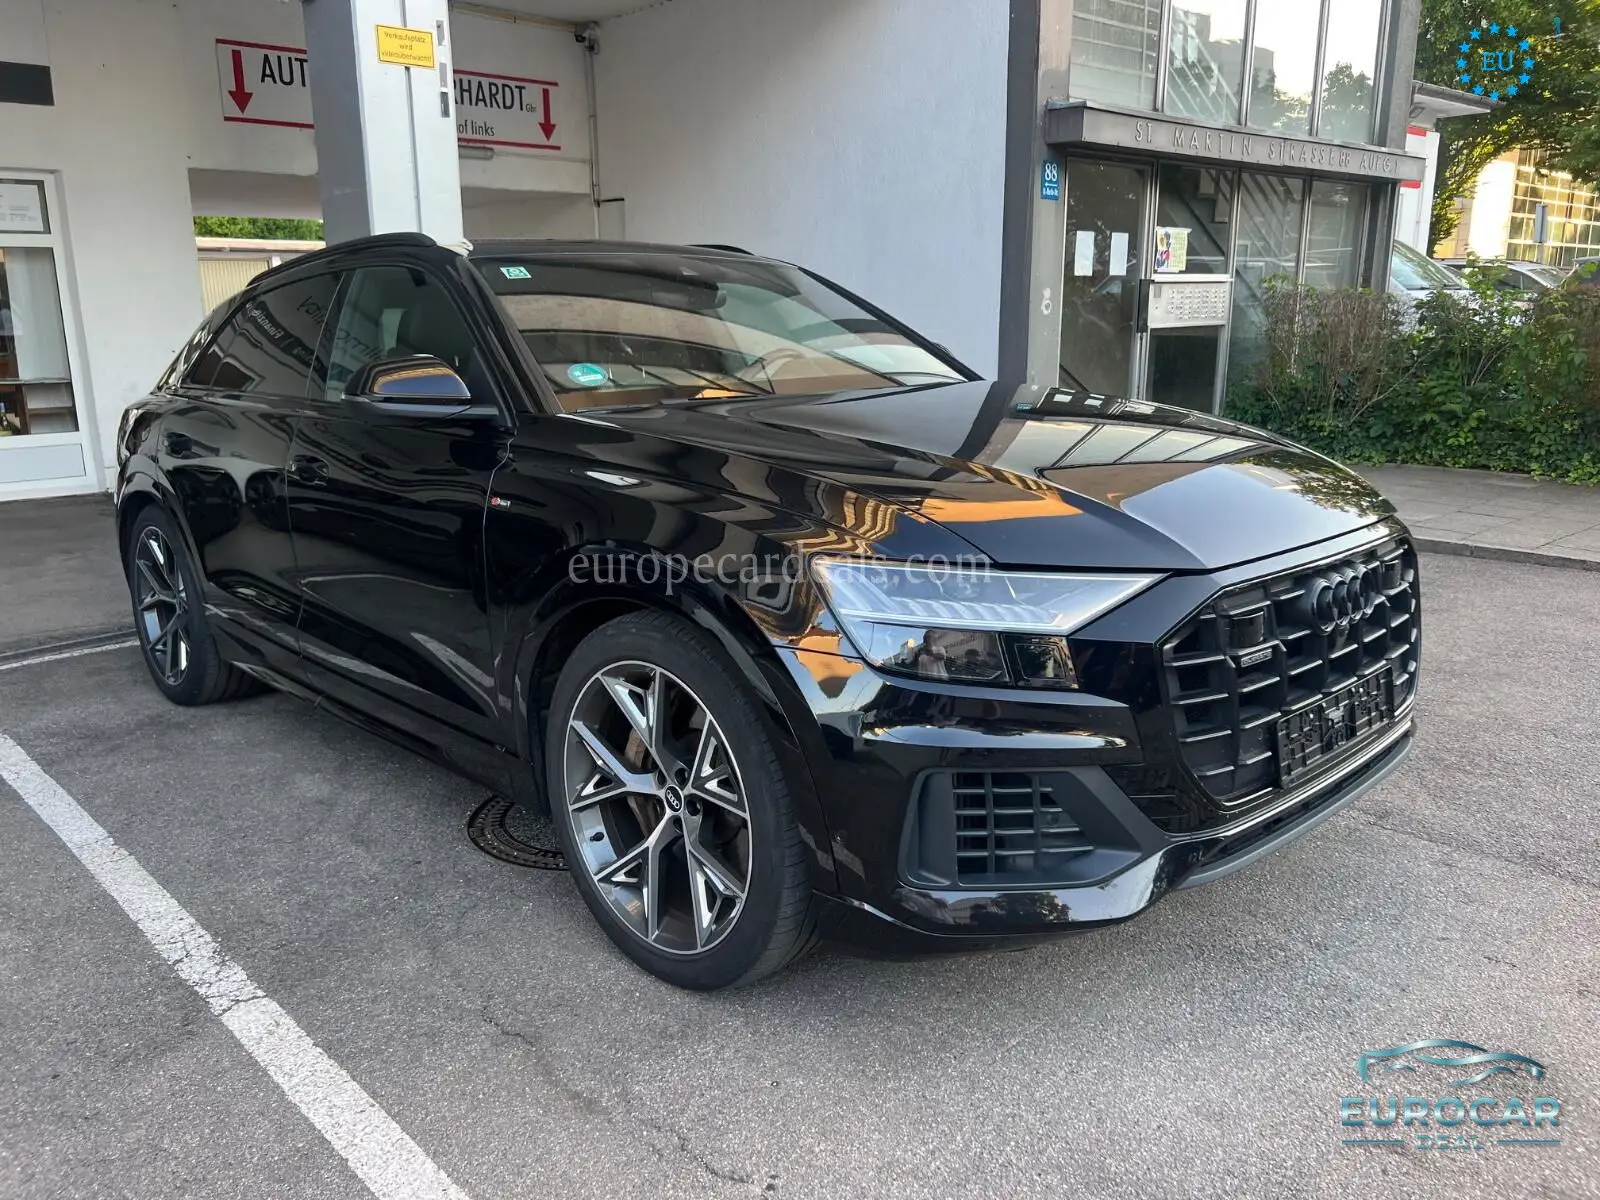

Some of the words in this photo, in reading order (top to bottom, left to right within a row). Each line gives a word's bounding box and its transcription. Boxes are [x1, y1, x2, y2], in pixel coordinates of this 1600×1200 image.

[470, 119, 495, 137] links
[1173, 126, 1252, 156] MARTIN
[1268, 141, 1335, 167] STRASSE
[1045, 163, 1058, 182] 88
